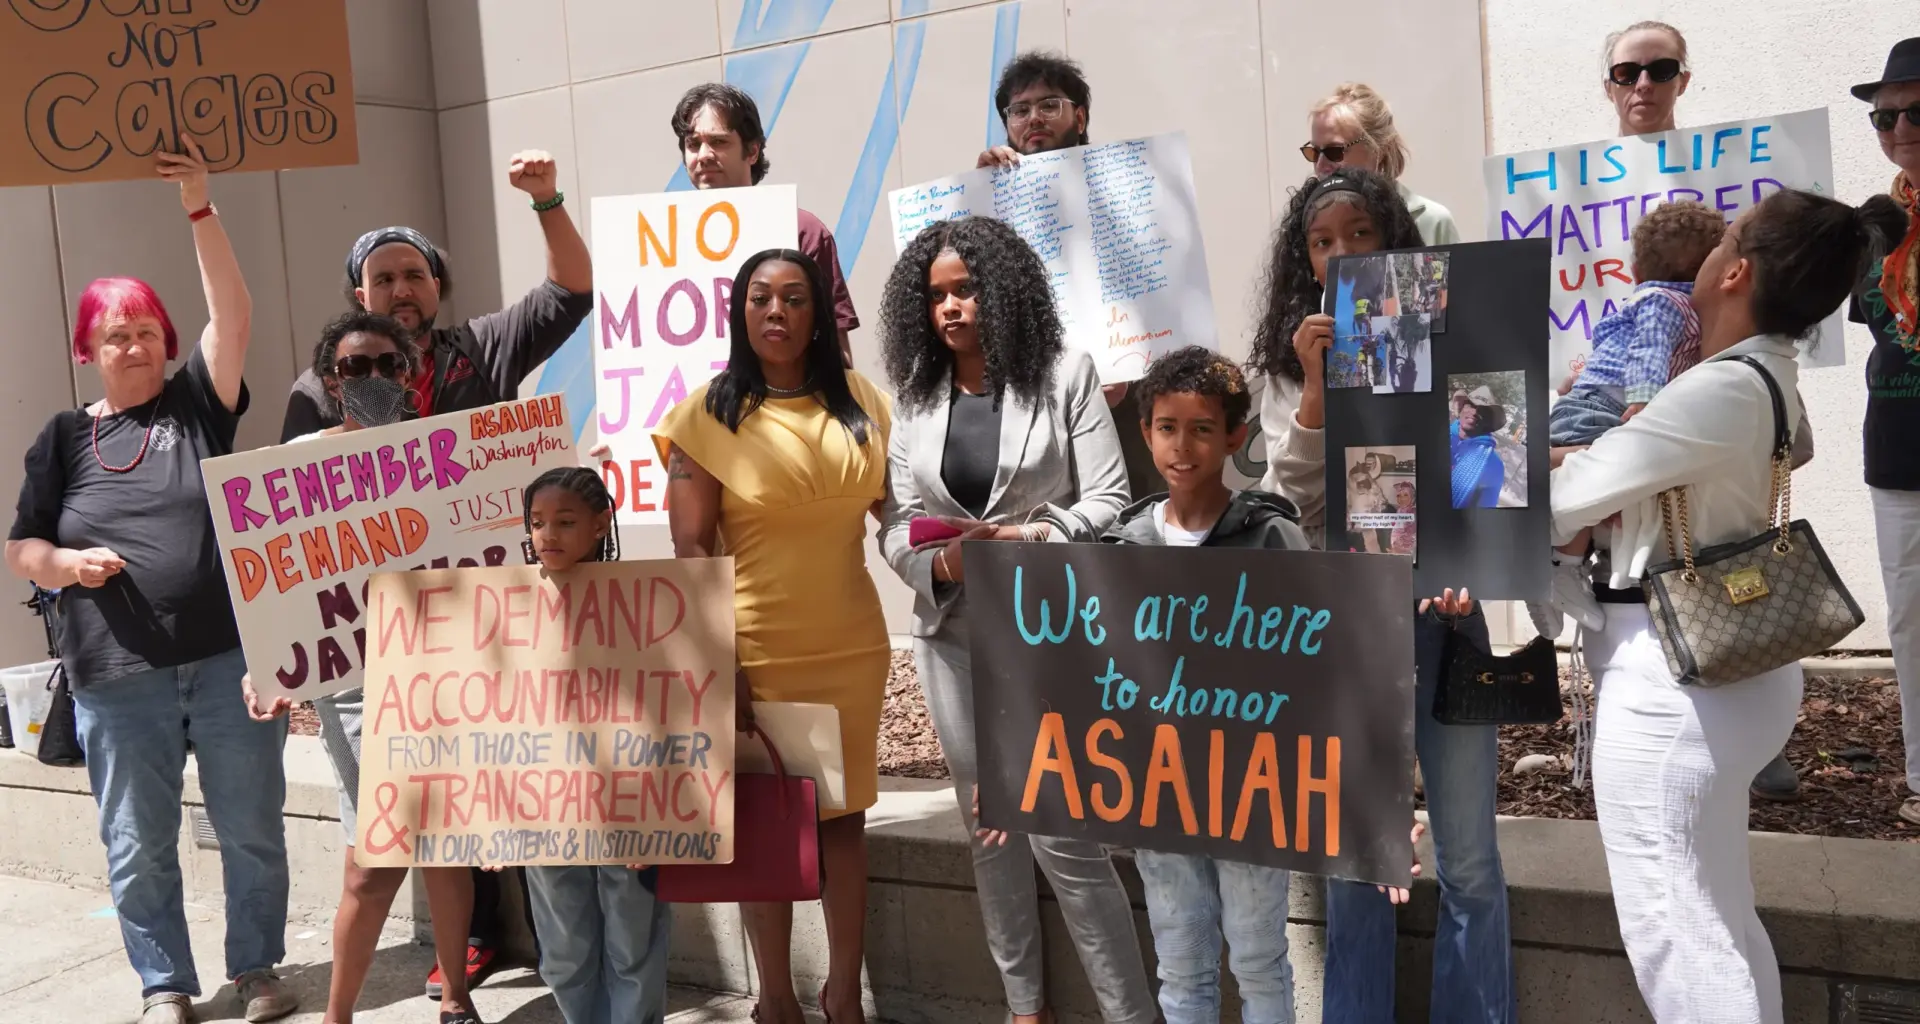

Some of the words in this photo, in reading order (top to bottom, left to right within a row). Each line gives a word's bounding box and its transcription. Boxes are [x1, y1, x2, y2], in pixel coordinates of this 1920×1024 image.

[107, 20, 217, 70] NOT
[25, 71, 338, 173] Cages
[1506, 145, 1627, 194] HIS
[1657, 125, 1772, 174] LIFE
[637, 201, 740, 268] NO
[466, 431, 569, 471] Washington
[470, 395, 564, 440] ASAIAH
[222, 428, 470, 532] REMEMBER
[231, 507, 430, 602] DEMAND
[378, 586, 455, 658] WE
[473, 577, 686, 652] DEMAND
[1014, 563, 1107, 646] We
[1134, 593, 1209, 643] are
[1214, 571, 1331, 656] here
[373, 666, 717, 735] ACCOUNTABILITY
[1094, 656, 1140, 711] to
[1150, 655, 1289, 725] honor
[388, 734, 460, 770] FROM
[469, 731, 553, 766] THOSE
[565, 730, 597, 767] IN
[613, 729, 712, 770] POWER
[365, 781, 412, 856] &
[408, 769, 731, 830] TRANSPARENCY
[1019, 712, 1342, 857] ASAIAH
[414, 833, 436, 863] IN
[443, 832, 483, 866] OUR
[486, 829, 561, 863] SYSTEMS
[562, 828, 581, 861] &
[585, 828, 721, 862] INSTITUTIONS
